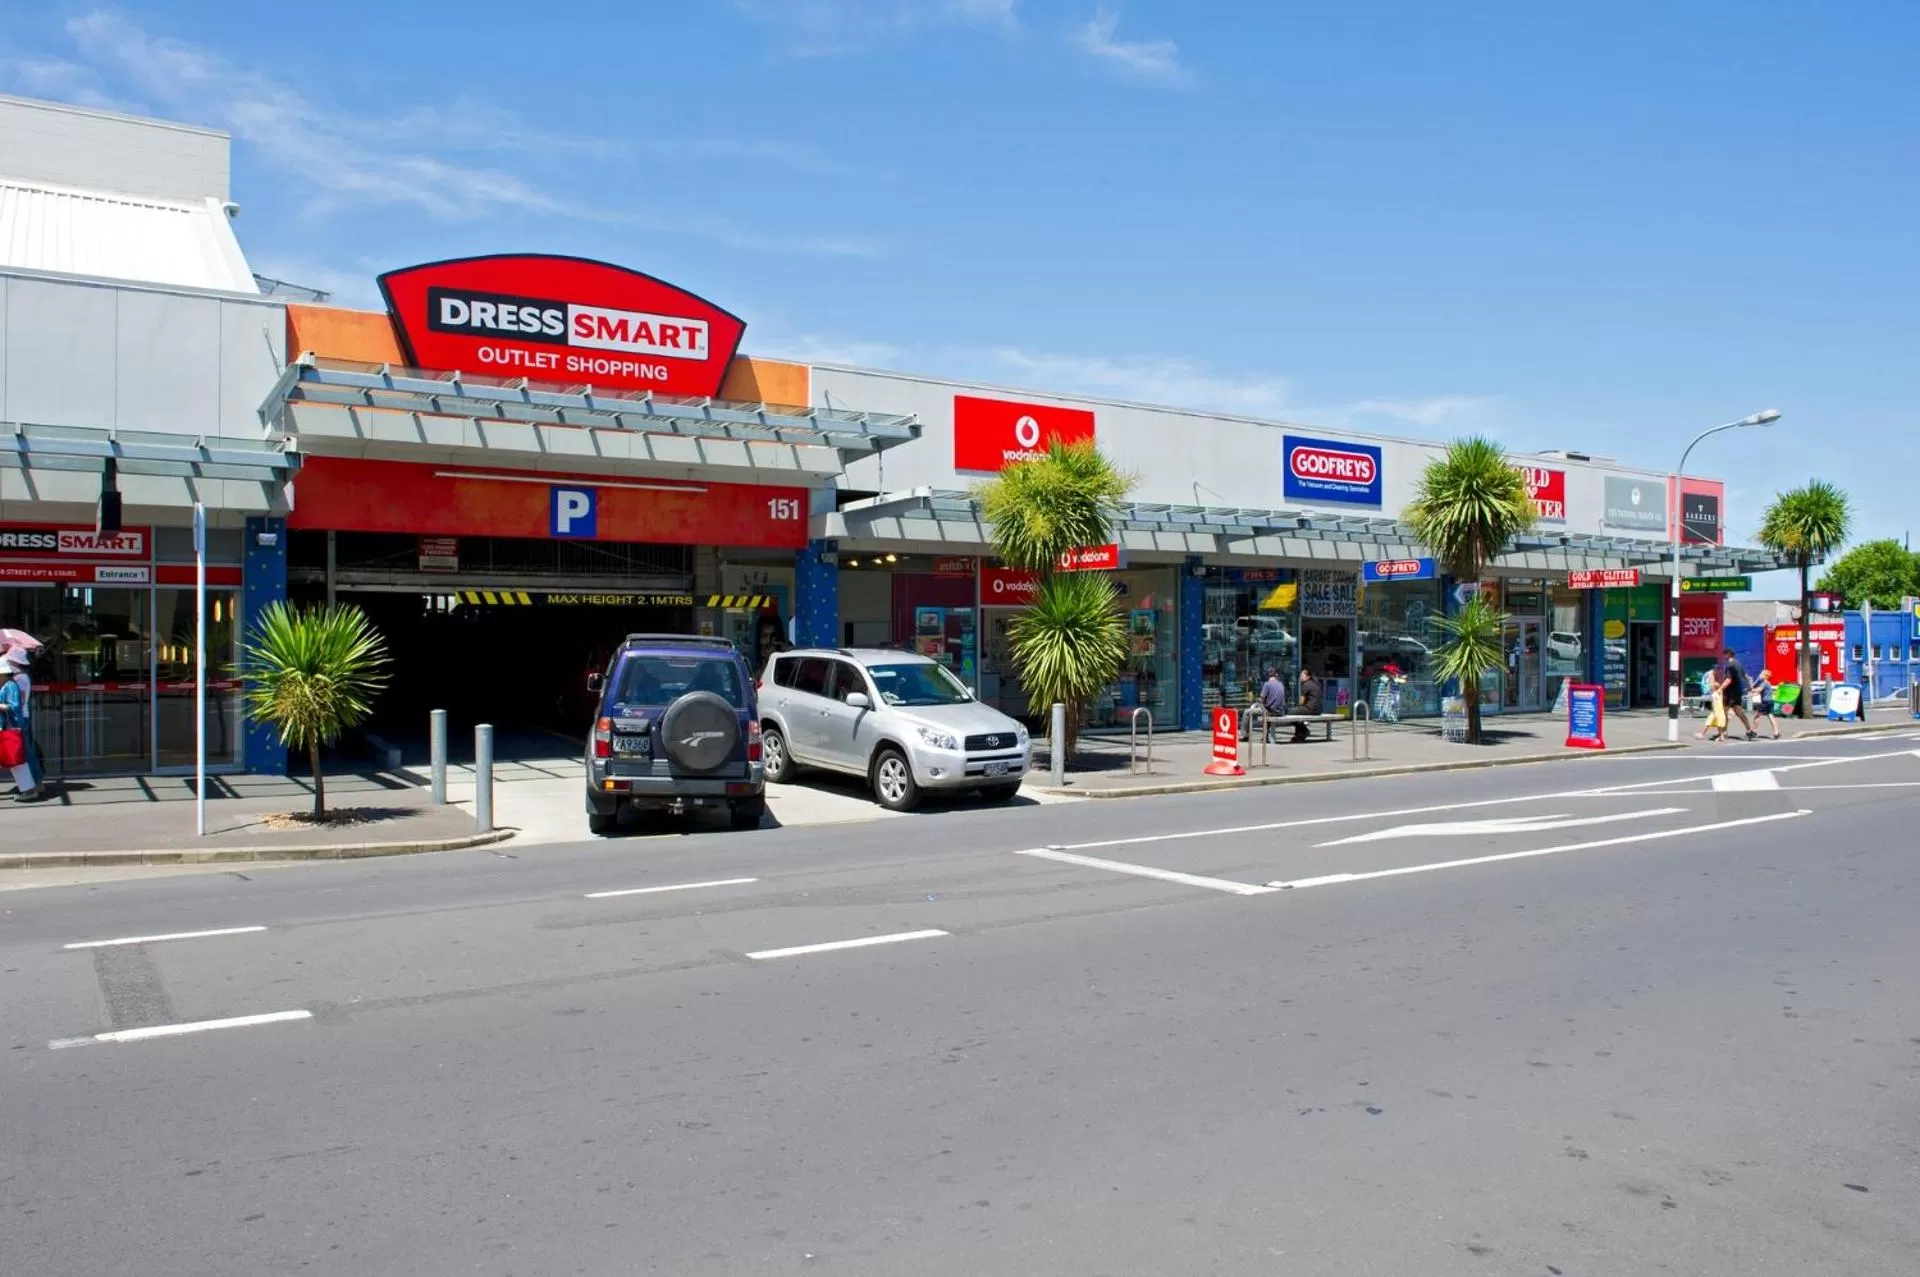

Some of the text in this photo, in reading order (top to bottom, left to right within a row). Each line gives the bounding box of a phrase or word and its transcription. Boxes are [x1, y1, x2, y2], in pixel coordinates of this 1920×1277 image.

[440, 297, 702, 350] DRESS SMART
[478, 346, 668, 381] OUTLET SHOPPING
[1296, 453, 1371, 479] GODFREYS
[557, 490, 590, 533] P
[768, 499, 799, 520] 151
[0, 533, 137, 550] RESS SMART
[100, 570, 145, 579] Entrance 1
[1572, 571, 1591, 581] GOLD
[1604, 570, 1635, 580] GLITTER
[547, 594, 693, 606] MAX HEIGHT 2.1MTRS
[1304, 583, 1356, 601] SALE SALE
[1684, 617, 1717, 635] ESPRIT
